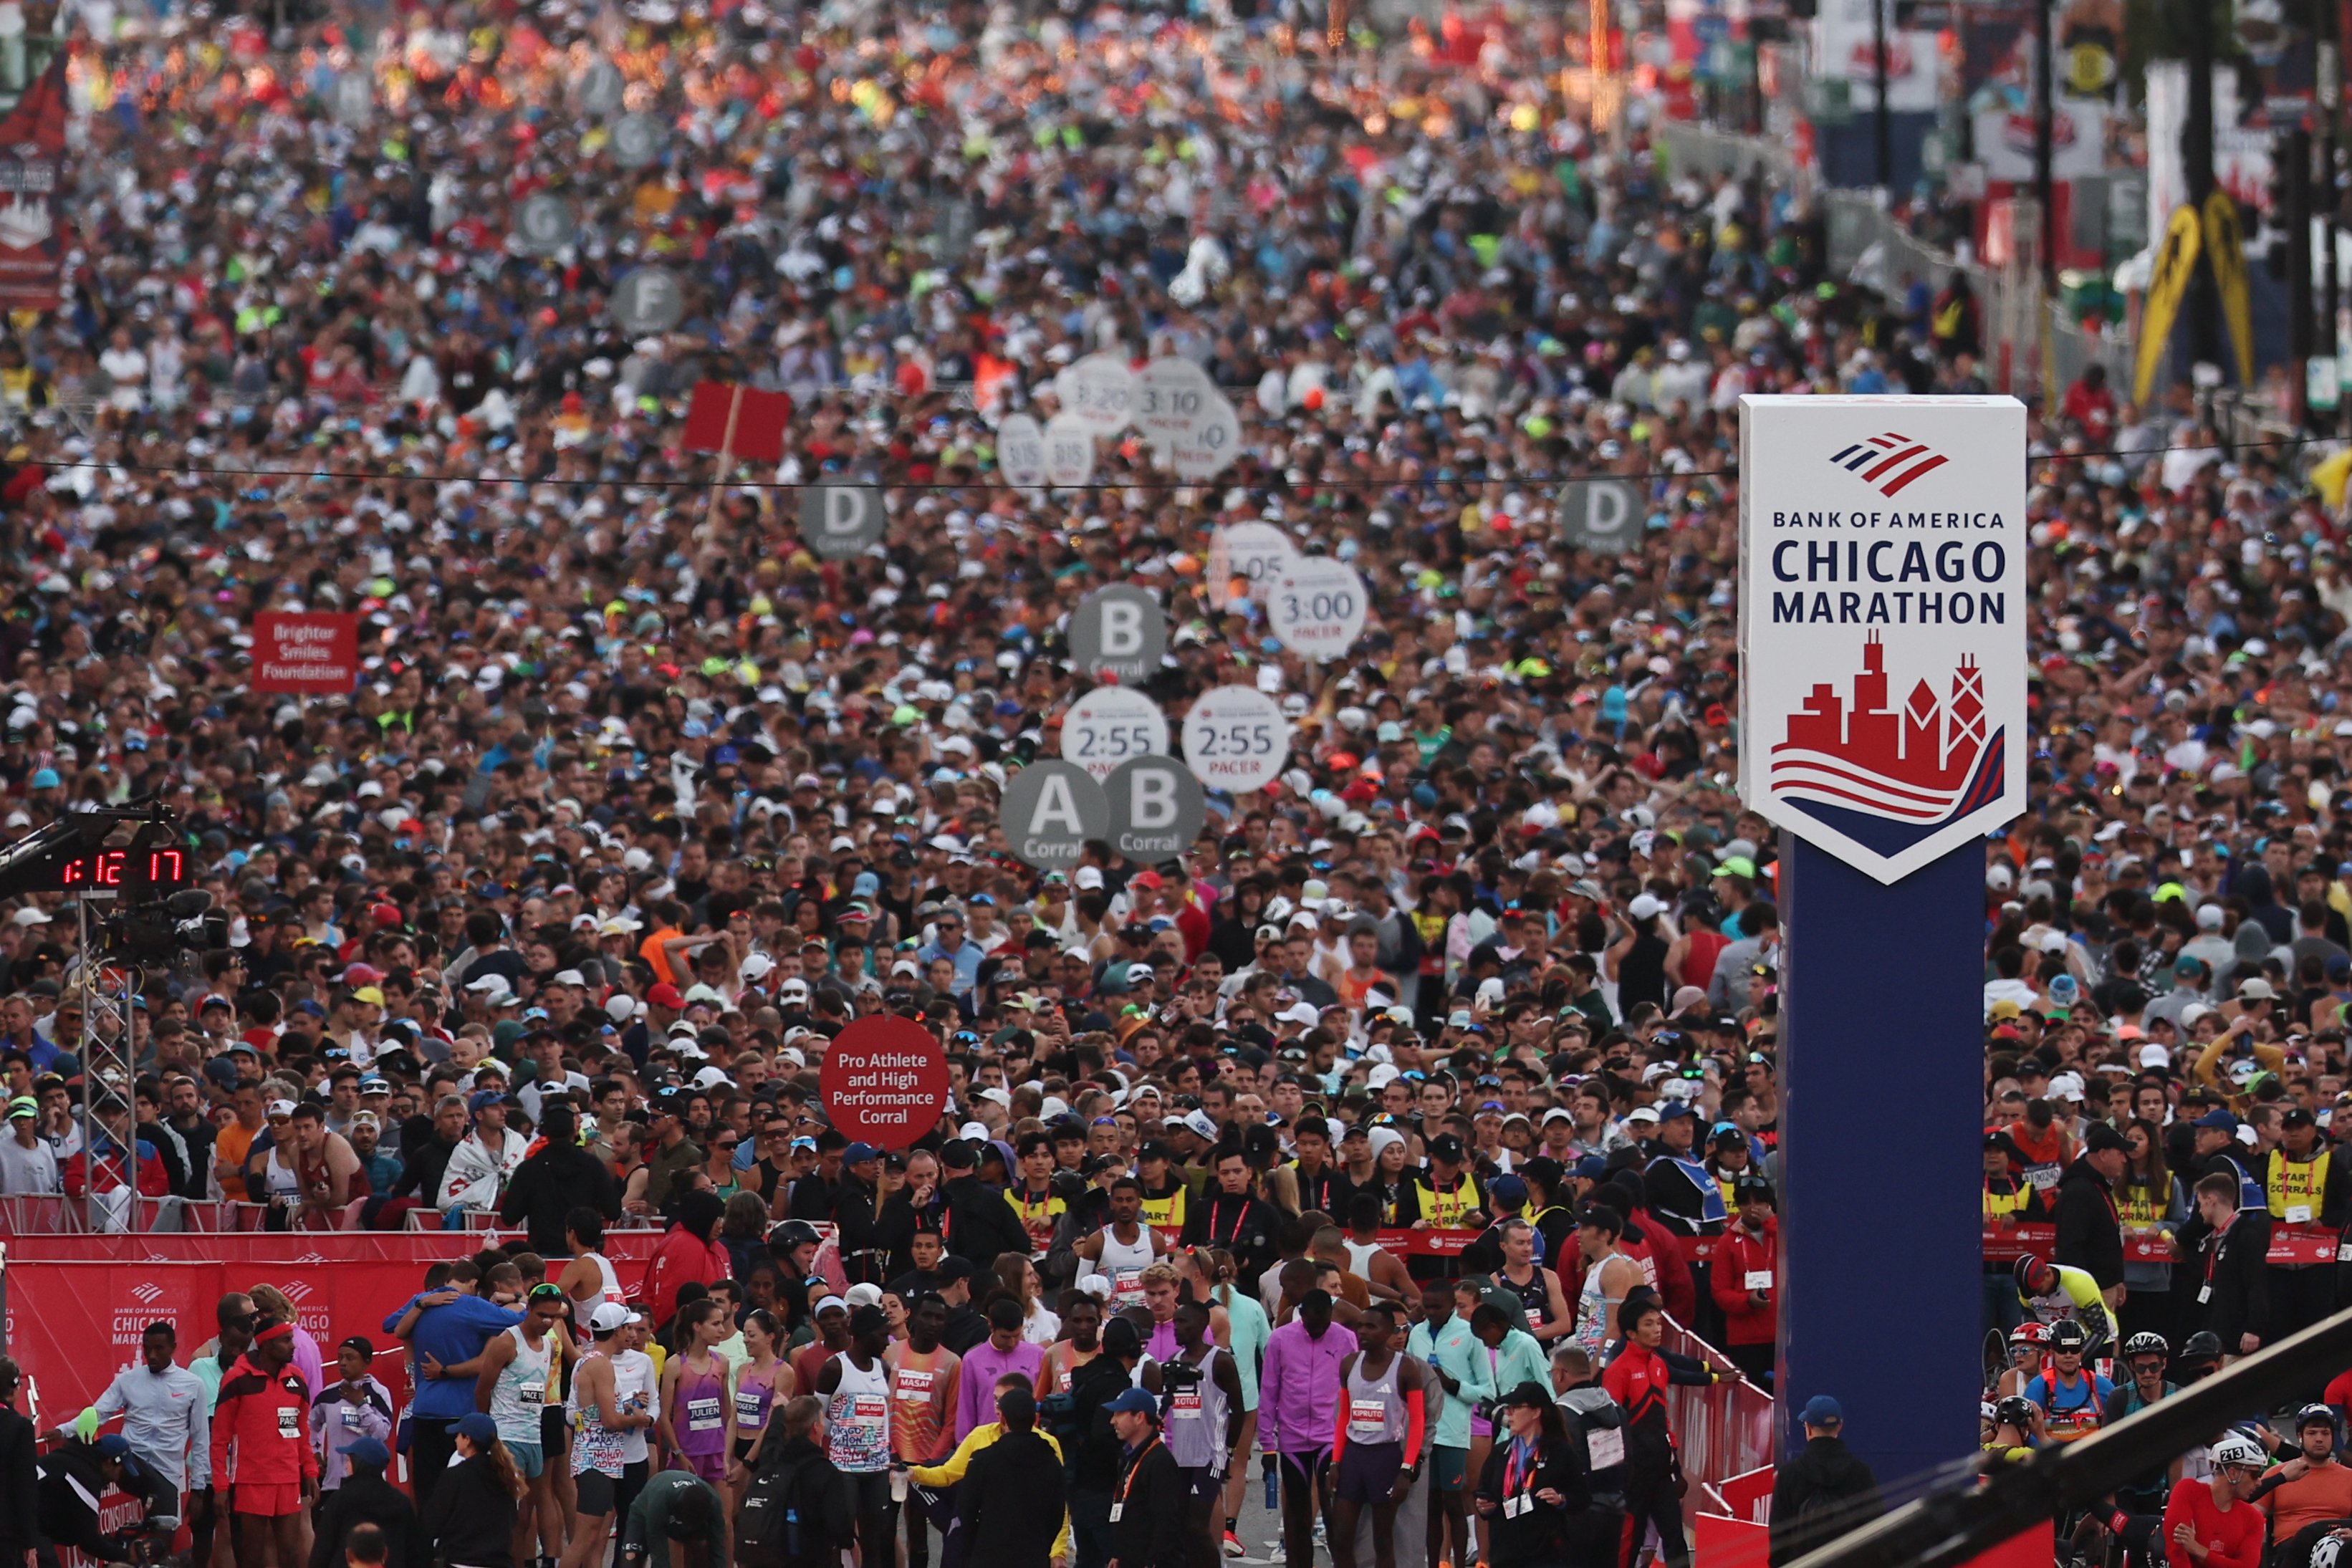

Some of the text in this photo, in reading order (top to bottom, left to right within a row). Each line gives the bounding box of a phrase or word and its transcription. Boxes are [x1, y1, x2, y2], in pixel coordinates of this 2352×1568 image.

[635, 276, 667, 319] F
[825, 486, 866, 534] D
[1587, 481, 1629, 533] D
[1773, 512, 2005, 529] BANK OF AMERICA
[1772, 540, 2006, 583] CHICAGO
[1281, 592, 1353, 624] 3:00
[1772, 592, 2005, 624] MARATHON
[274, 624, 337, 644] Brighter
[1101, 601, 1144, 655] B
[279, 643, 331, 660] Smiles
[262, 662, 347, 680] Foundation
[1090, 658, 1144, 677] Crral
[1077, 726, 1151, 757] 2:55
[1198, 725, 1272, 756] 2:55
[1209, 761, 1262, 775] PACER
[1028, 774, 1083, 834] A
[1131, 768, 1179, 829] B
[1024, 838, 1083, 858] Corral
[1120, 832, 1181, 852] Corral
[839, 1052, 927, 1068] Pro Athlete
[848, 1071, 918, 1090] and High
[833, 1090, 934, 1106] Performance
[860, 1109, 908, 1124] Corral
[900, 1378, 929, 1388] MASAI
[1174, 1397, 1200, 1405] KOTUT
[690, 1406, 719, 1419] JULIEN
[1353, 1409, 1383, 1418] KIPRUTO
[2222, 1448, 2243, 1461] 213
